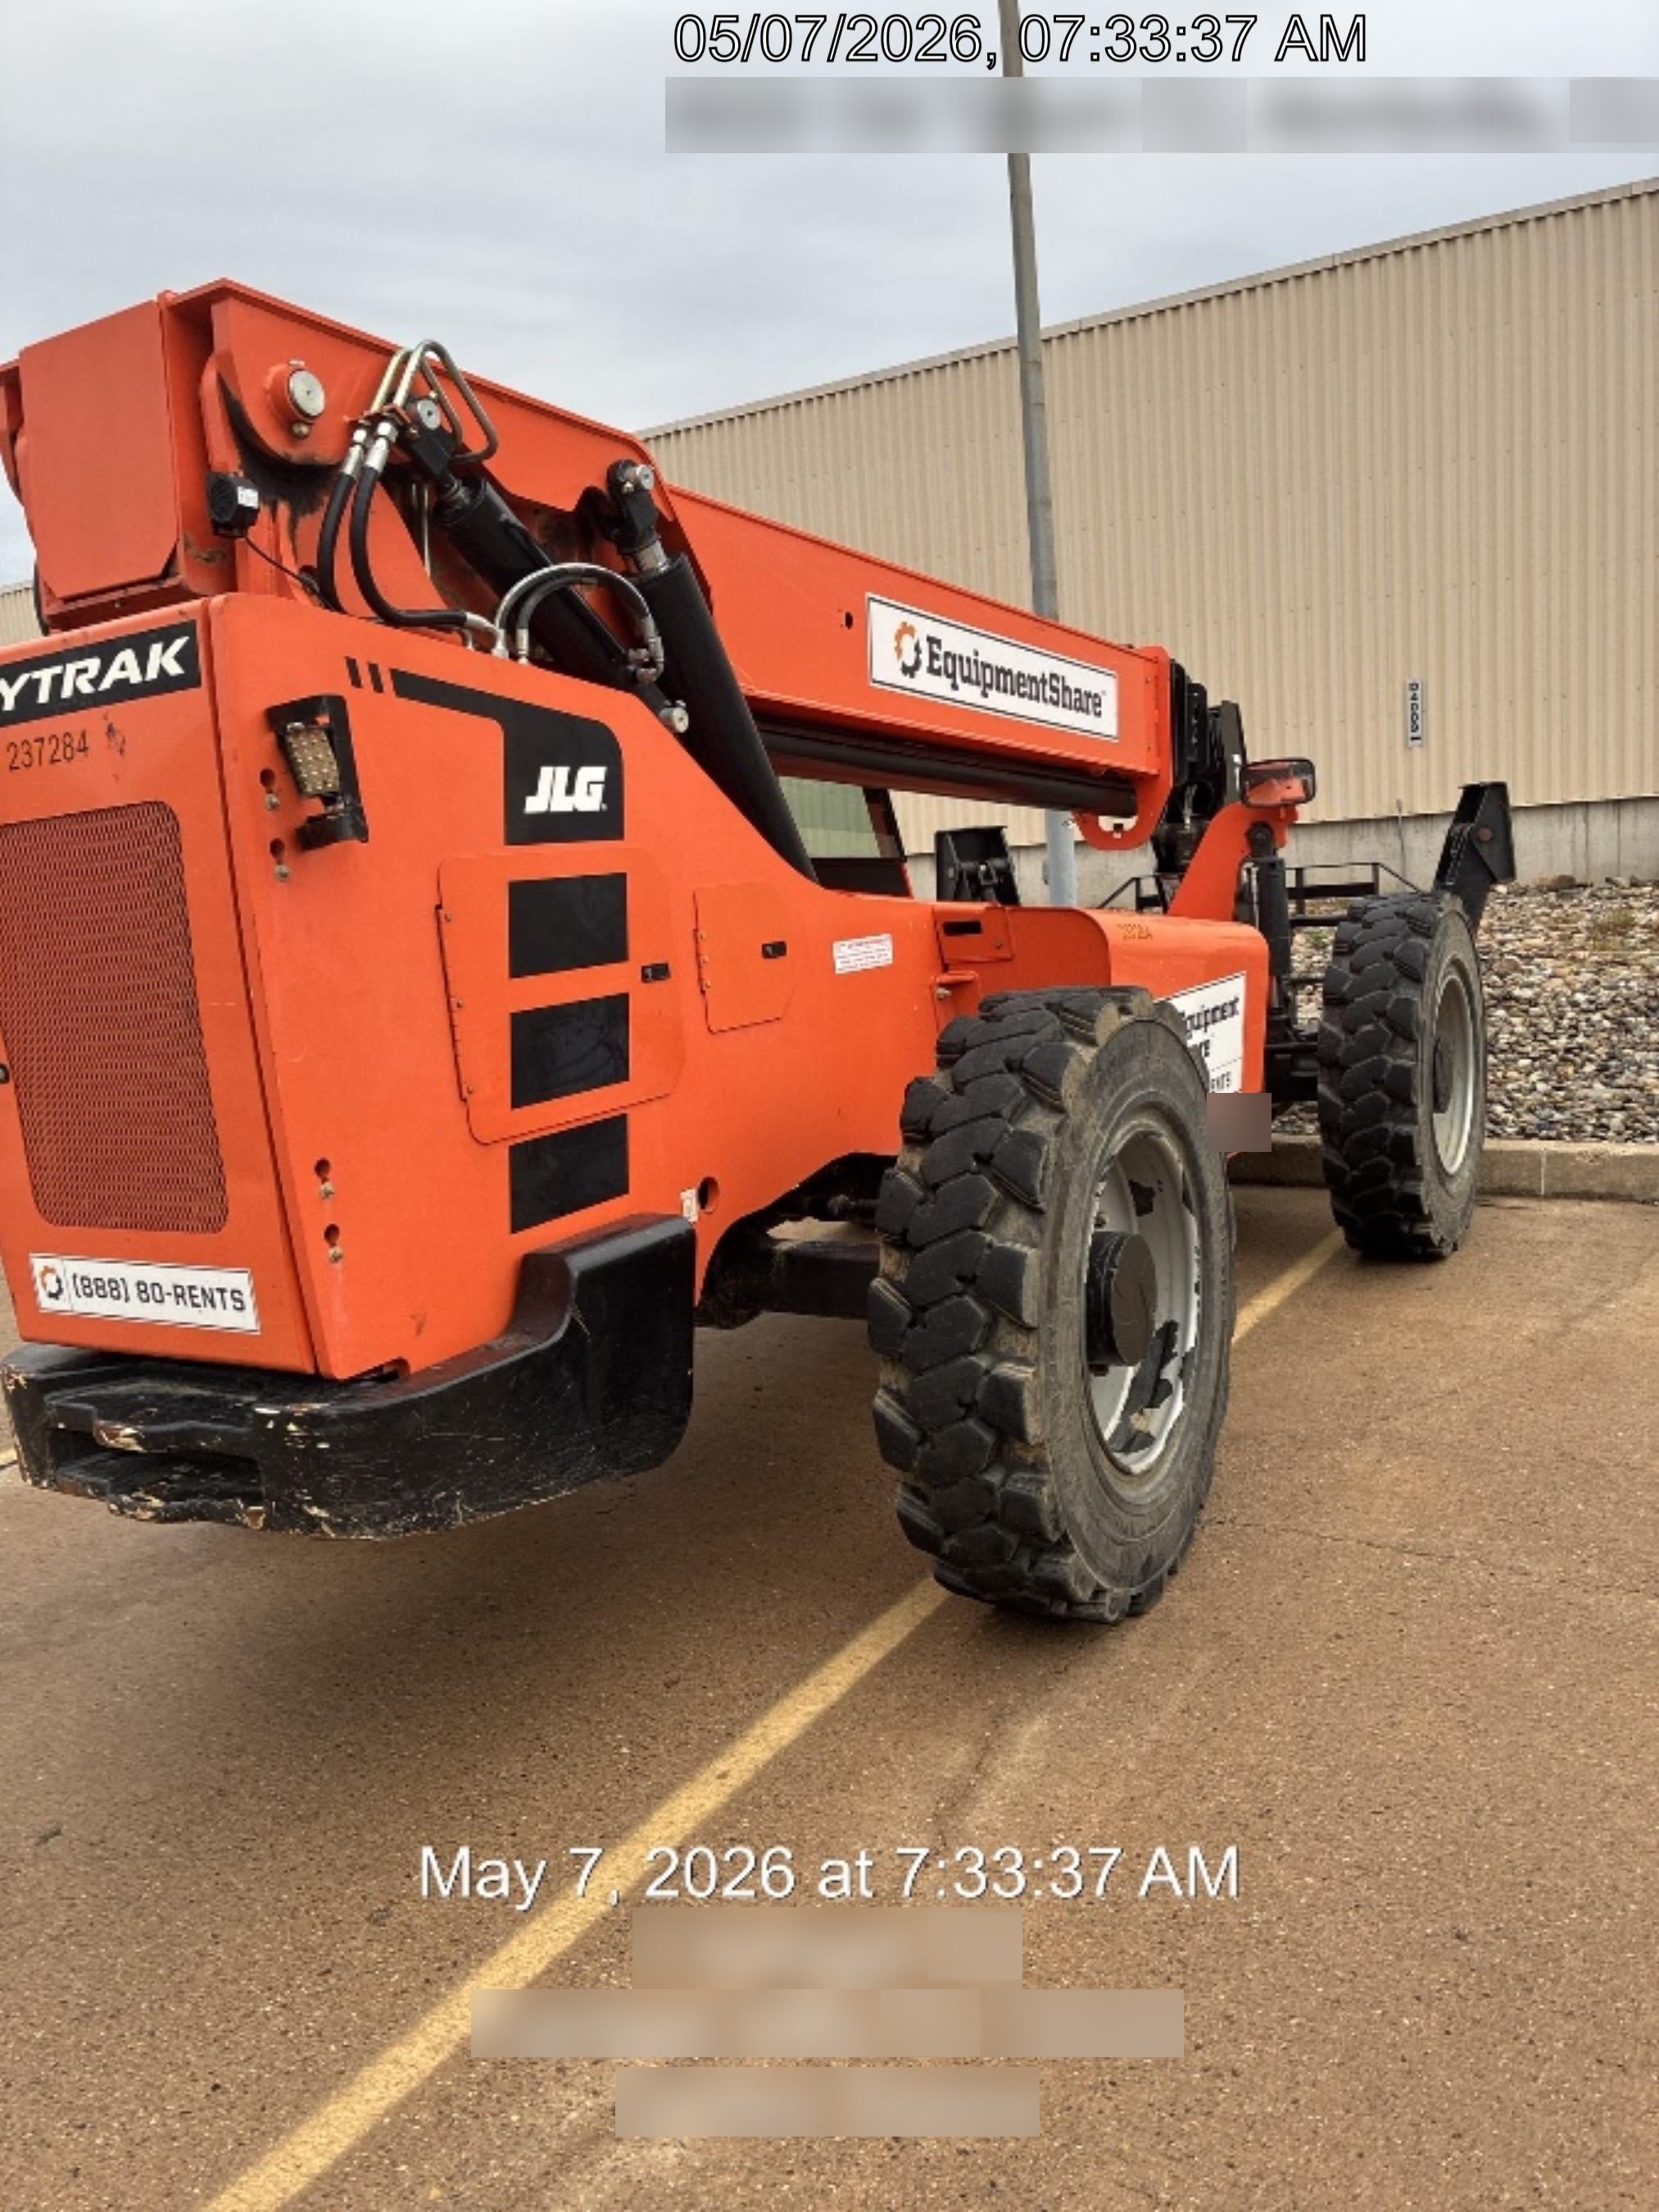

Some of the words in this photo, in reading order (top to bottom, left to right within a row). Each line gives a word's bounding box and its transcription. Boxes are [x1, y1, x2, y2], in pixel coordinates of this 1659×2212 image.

[926, 636, 1103, 718] EquipmentShare
[6, 729, 89, 771] 237284
[524, 765, 608, 814] JLG
[1179, 996, 1240, 1040] quipment
[72, 1272, 129, 1303] (888)
[135, 1280, 246, 1312] 80-RENTS
